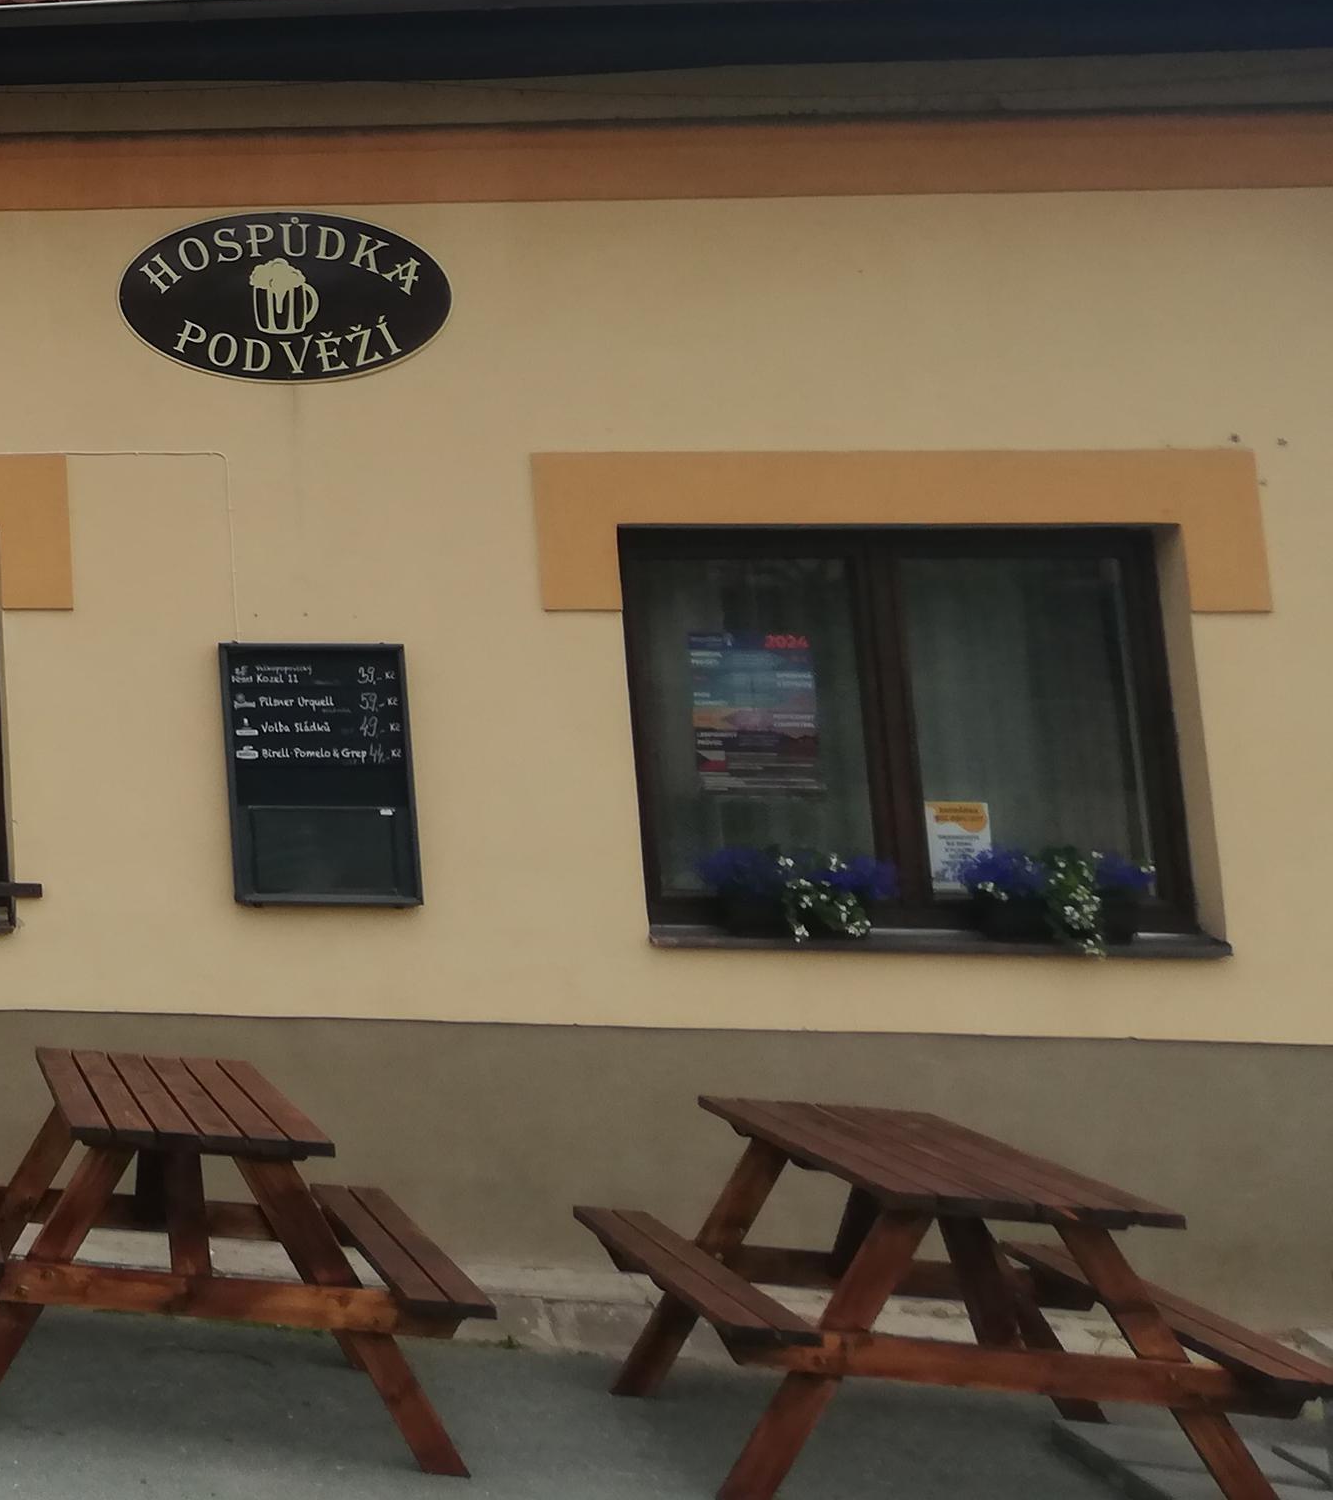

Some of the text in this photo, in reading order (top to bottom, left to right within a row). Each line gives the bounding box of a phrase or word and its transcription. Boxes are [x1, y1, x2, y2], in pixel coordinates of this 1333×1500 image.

[138, 217, 422, 296] HOSPŮDKA
[256, 674, 284, 684] Kozel
[258, 696, 294, 708] Pilsner
[297, 696, 335, 712] Urquell
[294, 748, 331, 759] Pomelo
[341, 748, 367, 764] Grep
